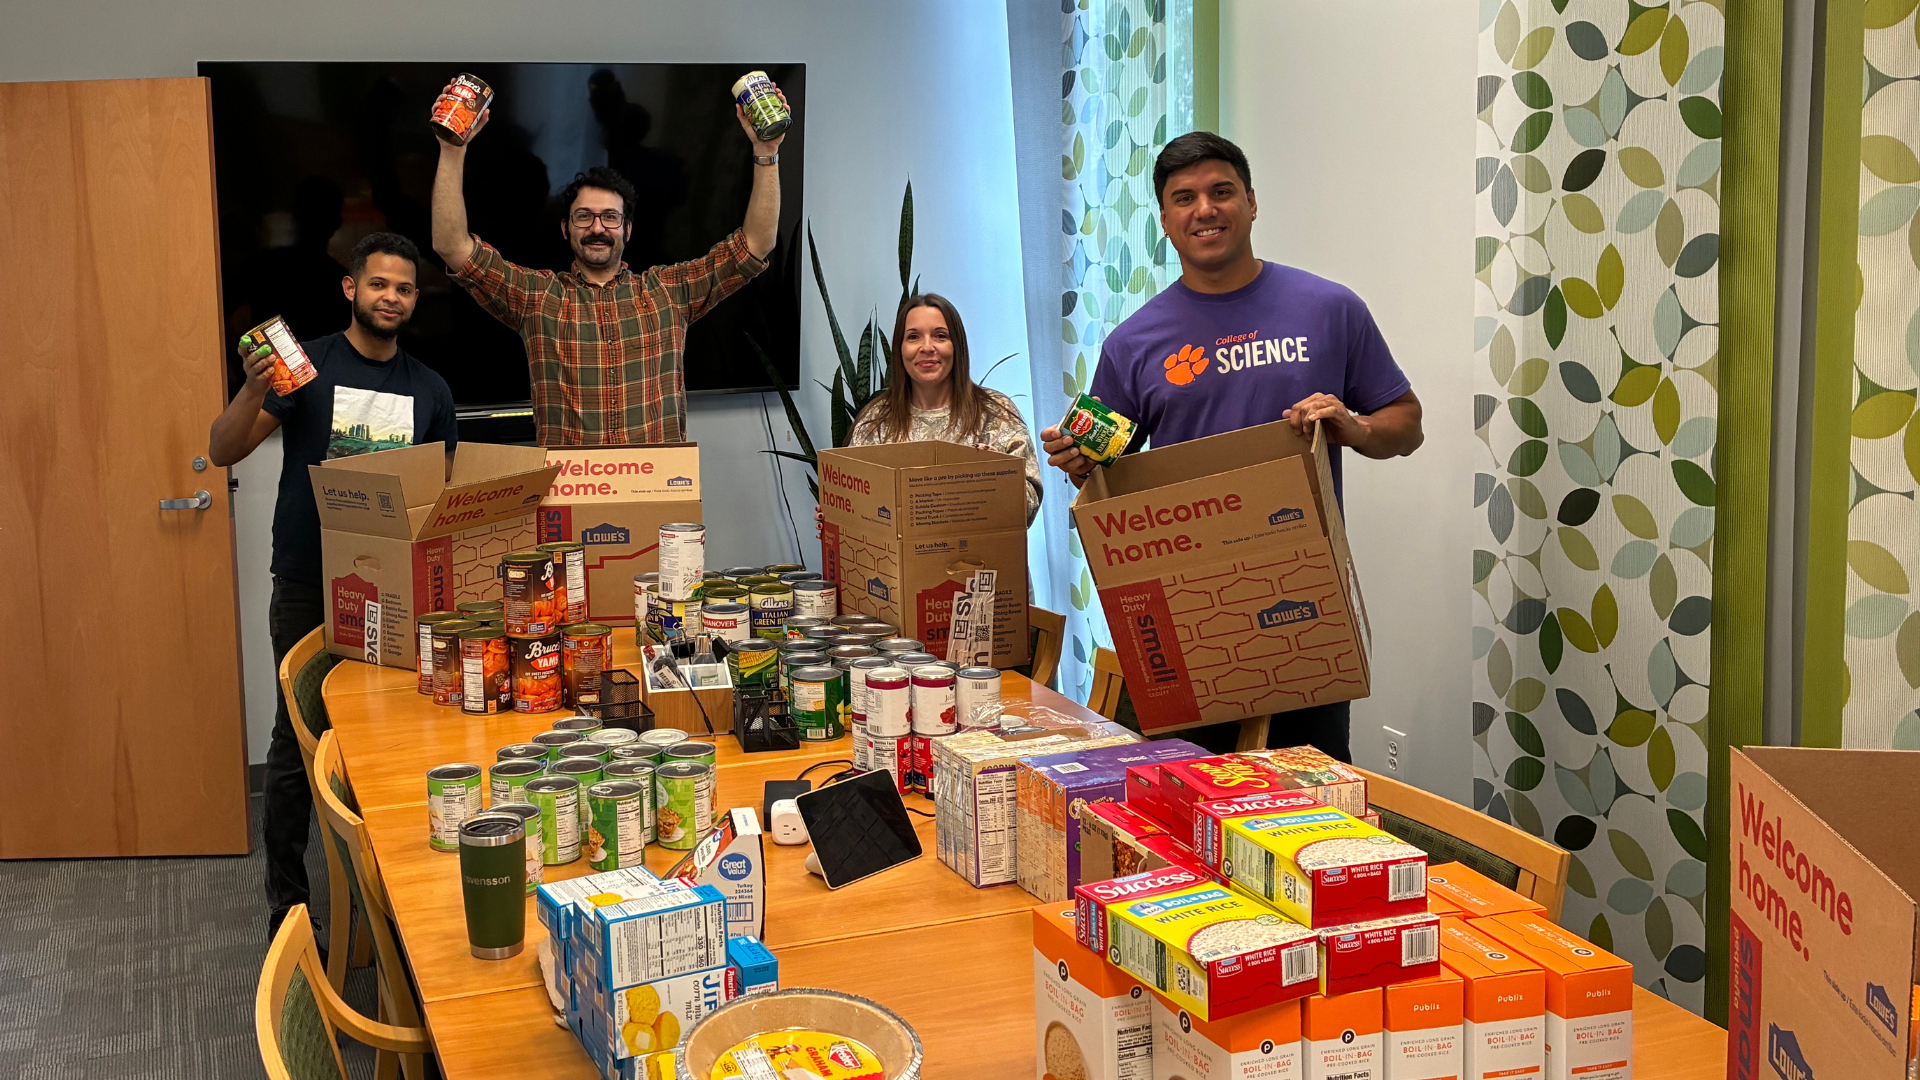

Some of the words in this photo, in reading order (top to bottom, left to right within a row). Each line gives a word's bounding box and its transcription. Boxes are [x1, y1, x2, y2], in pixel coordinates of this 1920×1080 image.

[454, 86, 472, 98] YAMS
[1216, 334, 1247, 346] College
[1248, 330, 1258, 340] of
[1216, 337, 1310, 374] SCIENCE
[546, 460, 654, 476] Welcome
[821, 462, 870, 495] Welcome
[323, 486, 336, 496] Let
[348, 489, 369, 501] help.
[446, 485, 523, 510] Welcome
[822, 485, 854, 514] home.
[432, 508, 485, 528] home.
[1093, 493, 1242, 538] Welcome
[1272, 512, 1300, 524] LOWE'S
[586, 531, 625, 543] LOWE'S
[427, 546, 444, 555] Heavy
[1102, 533, 1202, 566] home.
[427, 553, 440, 563] Duty
[338, 586, 365, 602] Heavy
[1120, 593, 1150, 604] Heavy
[338, 598, 358, 614] Duty
[1122, 603, 1146, 613] Duty
[1264, 605, 1311, 626] LOWE'S
[525, 641, 560, 659] Bruce's
[1137, 614, 1178, 683] small
[537, 656, 558, 668] YAMS
[1212, 795, 1315, 815] Success
[1194, 814, 1203, 857] Success
[1268, 827, 1315, 837] WHITE
[722, 860, 746, 869] Great
[1738, 782, 1853, 936] Welcome
[1351, 865, 1369, 873] WHITE
[1094, 872, 1196, 900] Success
[1322, 875, 1346, 883] Success
[1739, 841, 1810, 962] home.
[1078, 896, 1086, 942] Success
[1155, 907, 1204, 923] WHITE
[1209, 901, 1243, 912] RICE
[1364, 930, 1382, 939] WHITE
[1337, 941, 1360, 950] Success
[1245, 952, 1262, 961] WHITE
[1218, 964, 1240, 975] Success
[693, 980, 701, 1002] corn
[702, 974, 720, 1010] JIF
[1498, 994, 1523, 1003] Publix
[1586, 989, 1611, 998] Publix
[1414, 1003, 1440, 1012] Publix
[1870, 987, 1894, 1029] LOWE'S
[1118, 1026, 1141, 1036] Nutrition
[1487, 1032, 1535, 1045] BOIL-IN-BAG
[1576, 1027, 1623, 1040] BOIL-IN-BAG
[1403, 1042, 1452, 1053] BOIL-IN-BAG
[806, 1047, 833, 1077] GRAHAM
[1323, 1050, 1372, 1062] BOIL-IN-BAG
[1244, 1060, 1292, 1074] BOIL-IN-BAG
